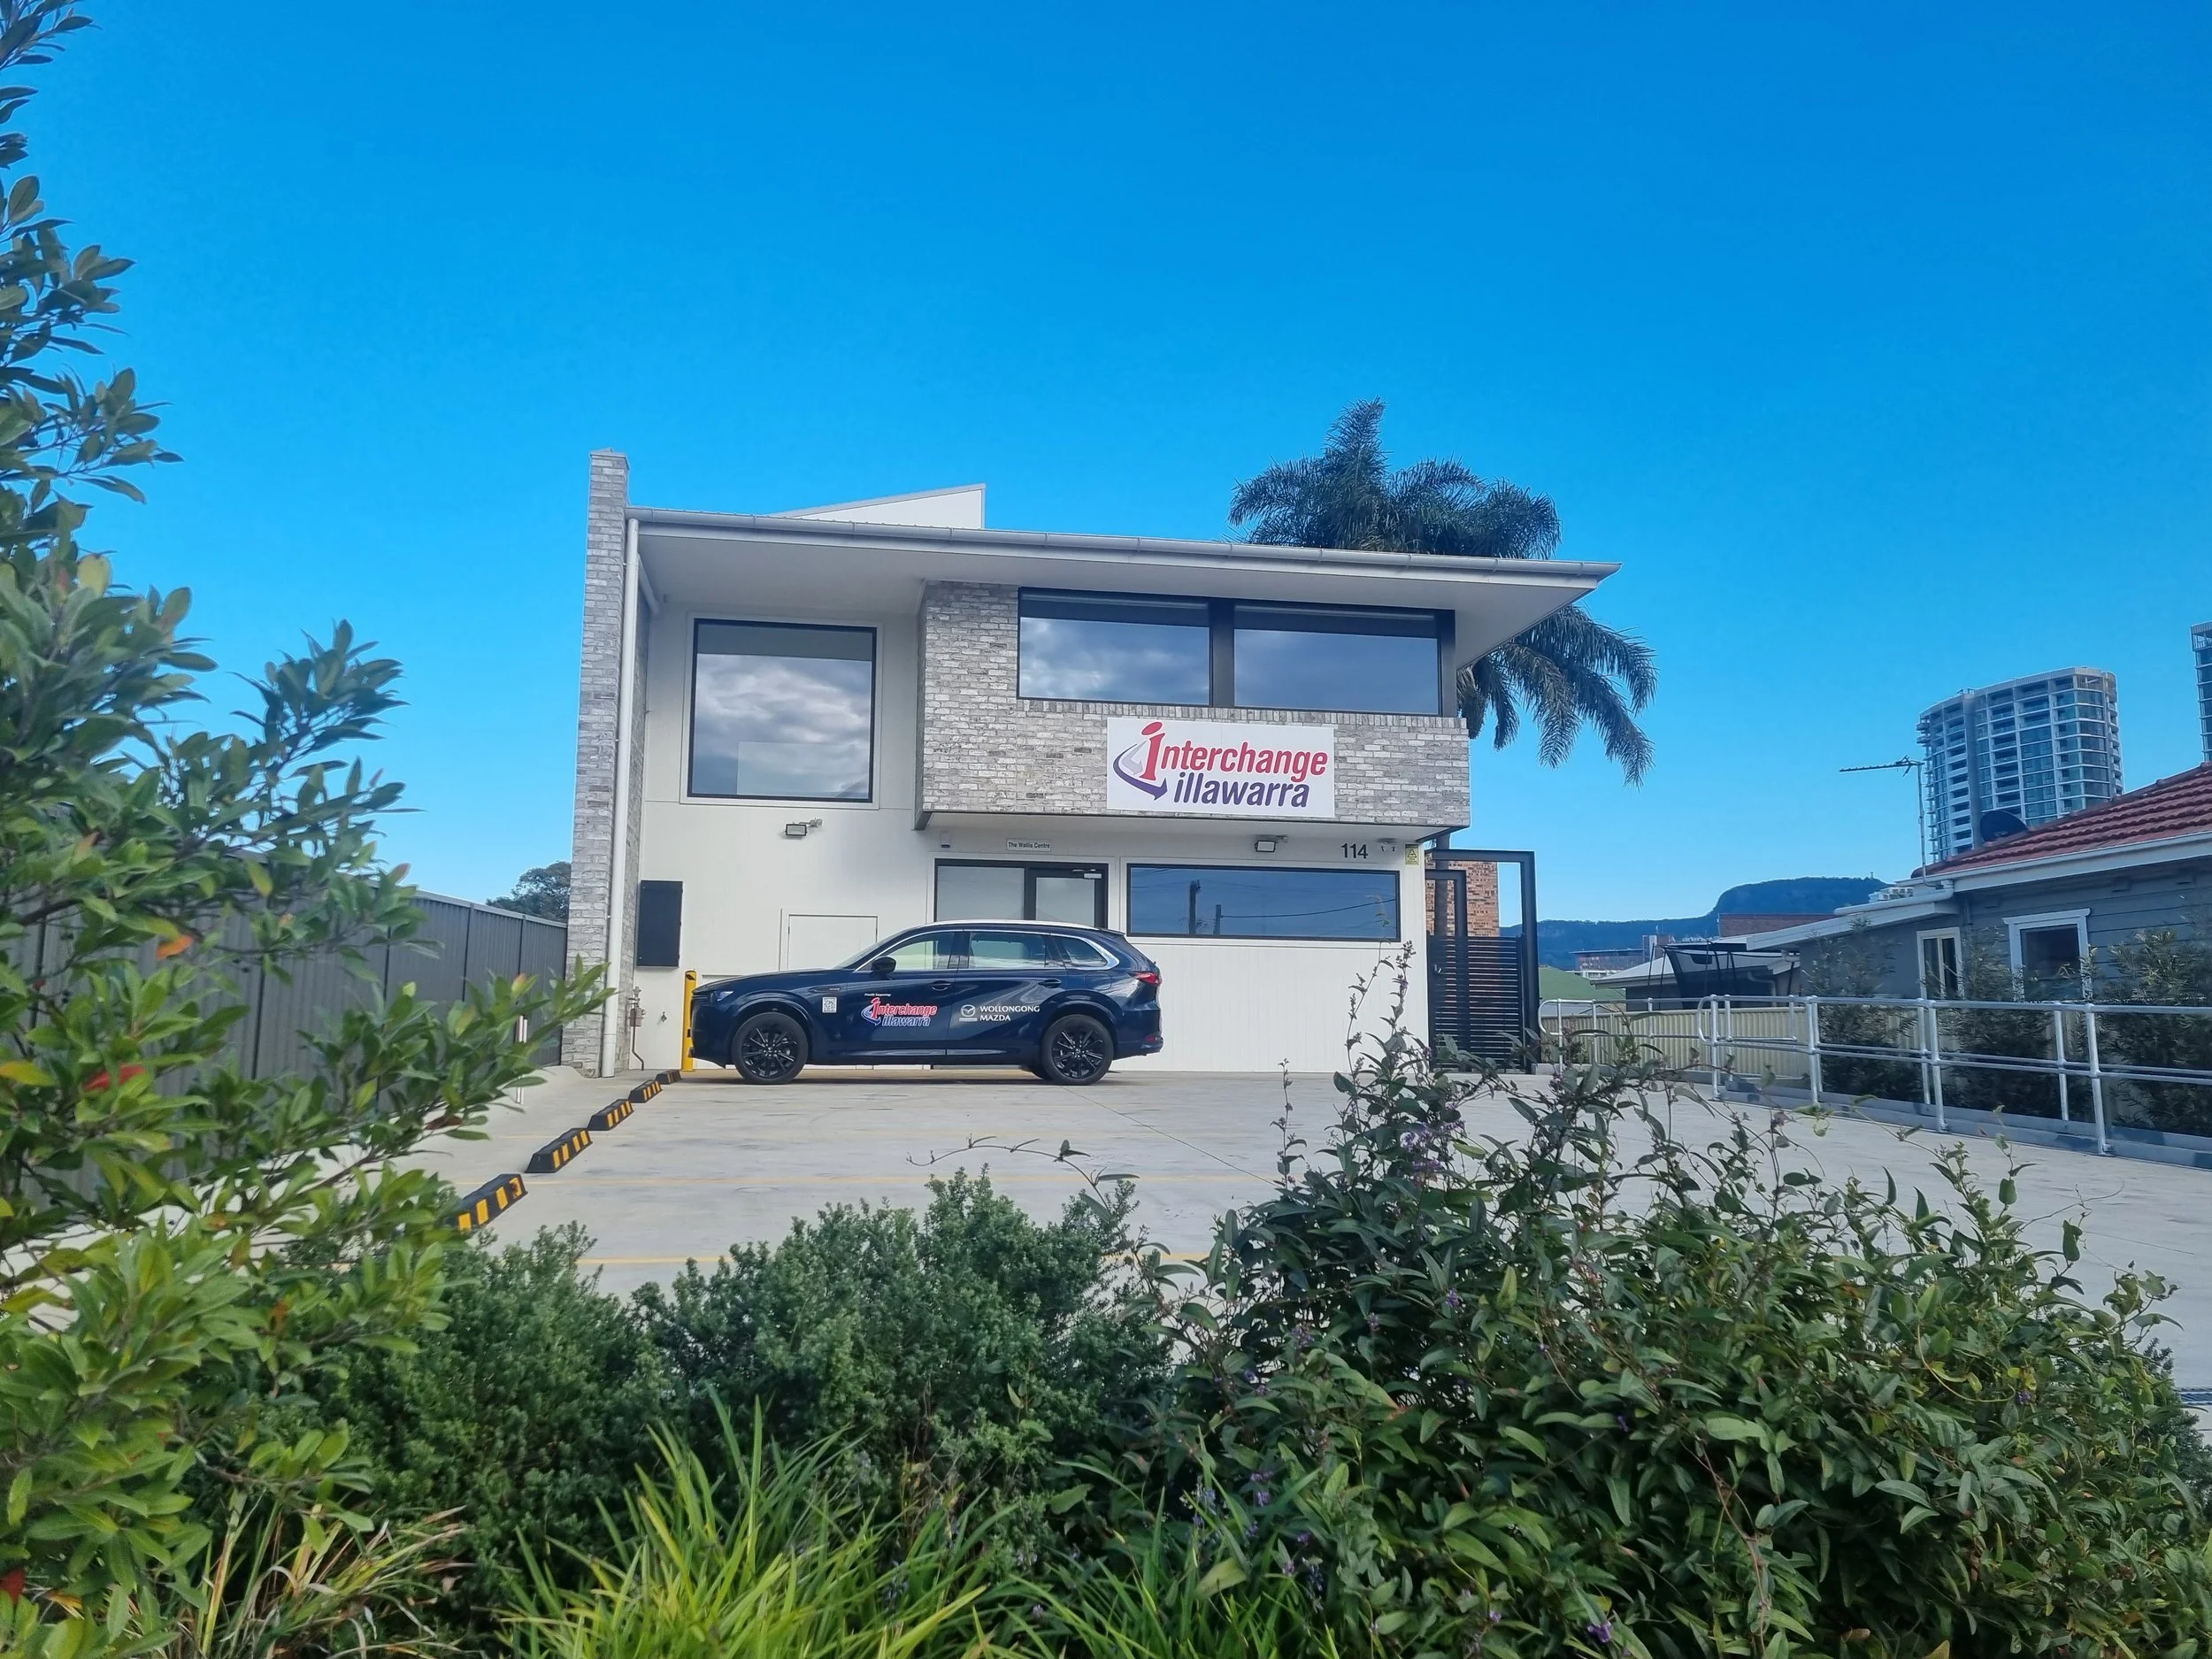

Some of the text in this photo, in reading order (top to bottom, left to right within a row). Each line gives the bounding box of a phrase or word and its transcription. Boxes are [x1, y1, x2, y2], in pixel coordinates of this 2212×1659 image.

[1173, 772, 1310, 808] illawarra
[1341, 843, 1368, 859] 114
[882, 1015, 931, 1026] illawarra
